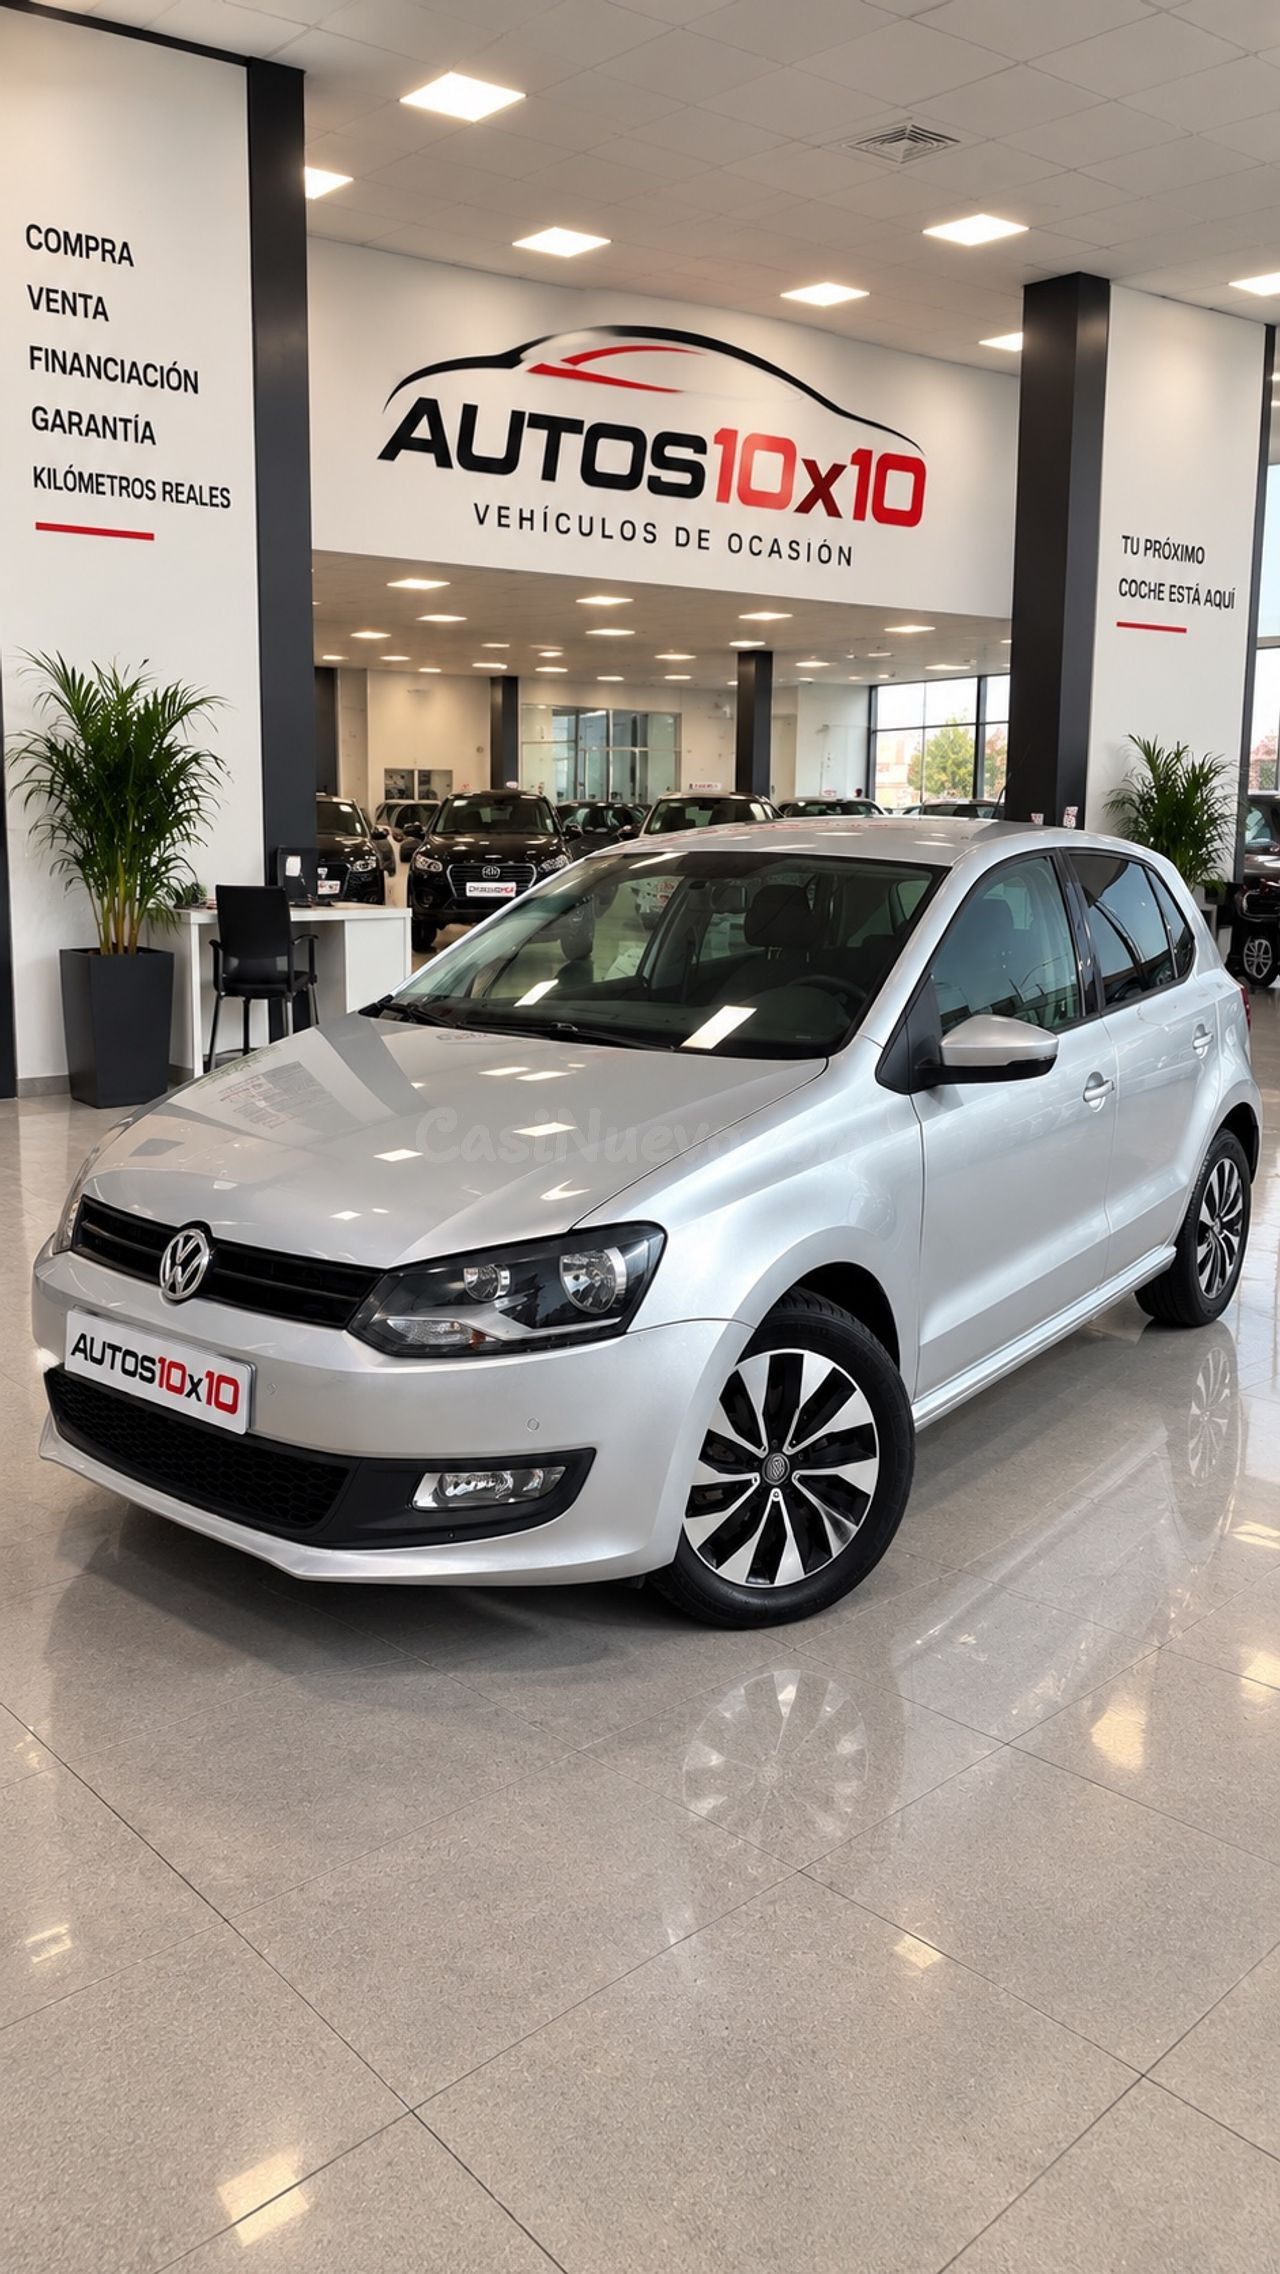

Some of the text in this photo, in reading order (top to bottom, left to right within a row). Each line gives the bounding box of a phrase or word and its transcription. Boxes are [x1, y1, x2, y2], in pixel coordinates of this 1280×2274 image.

[25, 224, 135, 267] COMPRA
[27, 284, 109, 322] VENTA
[29, 345, 199, 394] FINANCIACIÓN
[31, 405, 156, 445] GARANTÍA
[377, 396, 927, 528] AUTOS10x10
[33, 464, 231, 508] KILÓMETROS REALES
[473, 502, 853, 566] VEHÍCULOS DE OCASIÓN
[1122, 535, 1205, 564] TU PRÓXIMO
[1119, 578, 1236, 610] COCHE ESTÁ AQUÍ
[70, 1333, 240, 1415] AUTOS10x10
